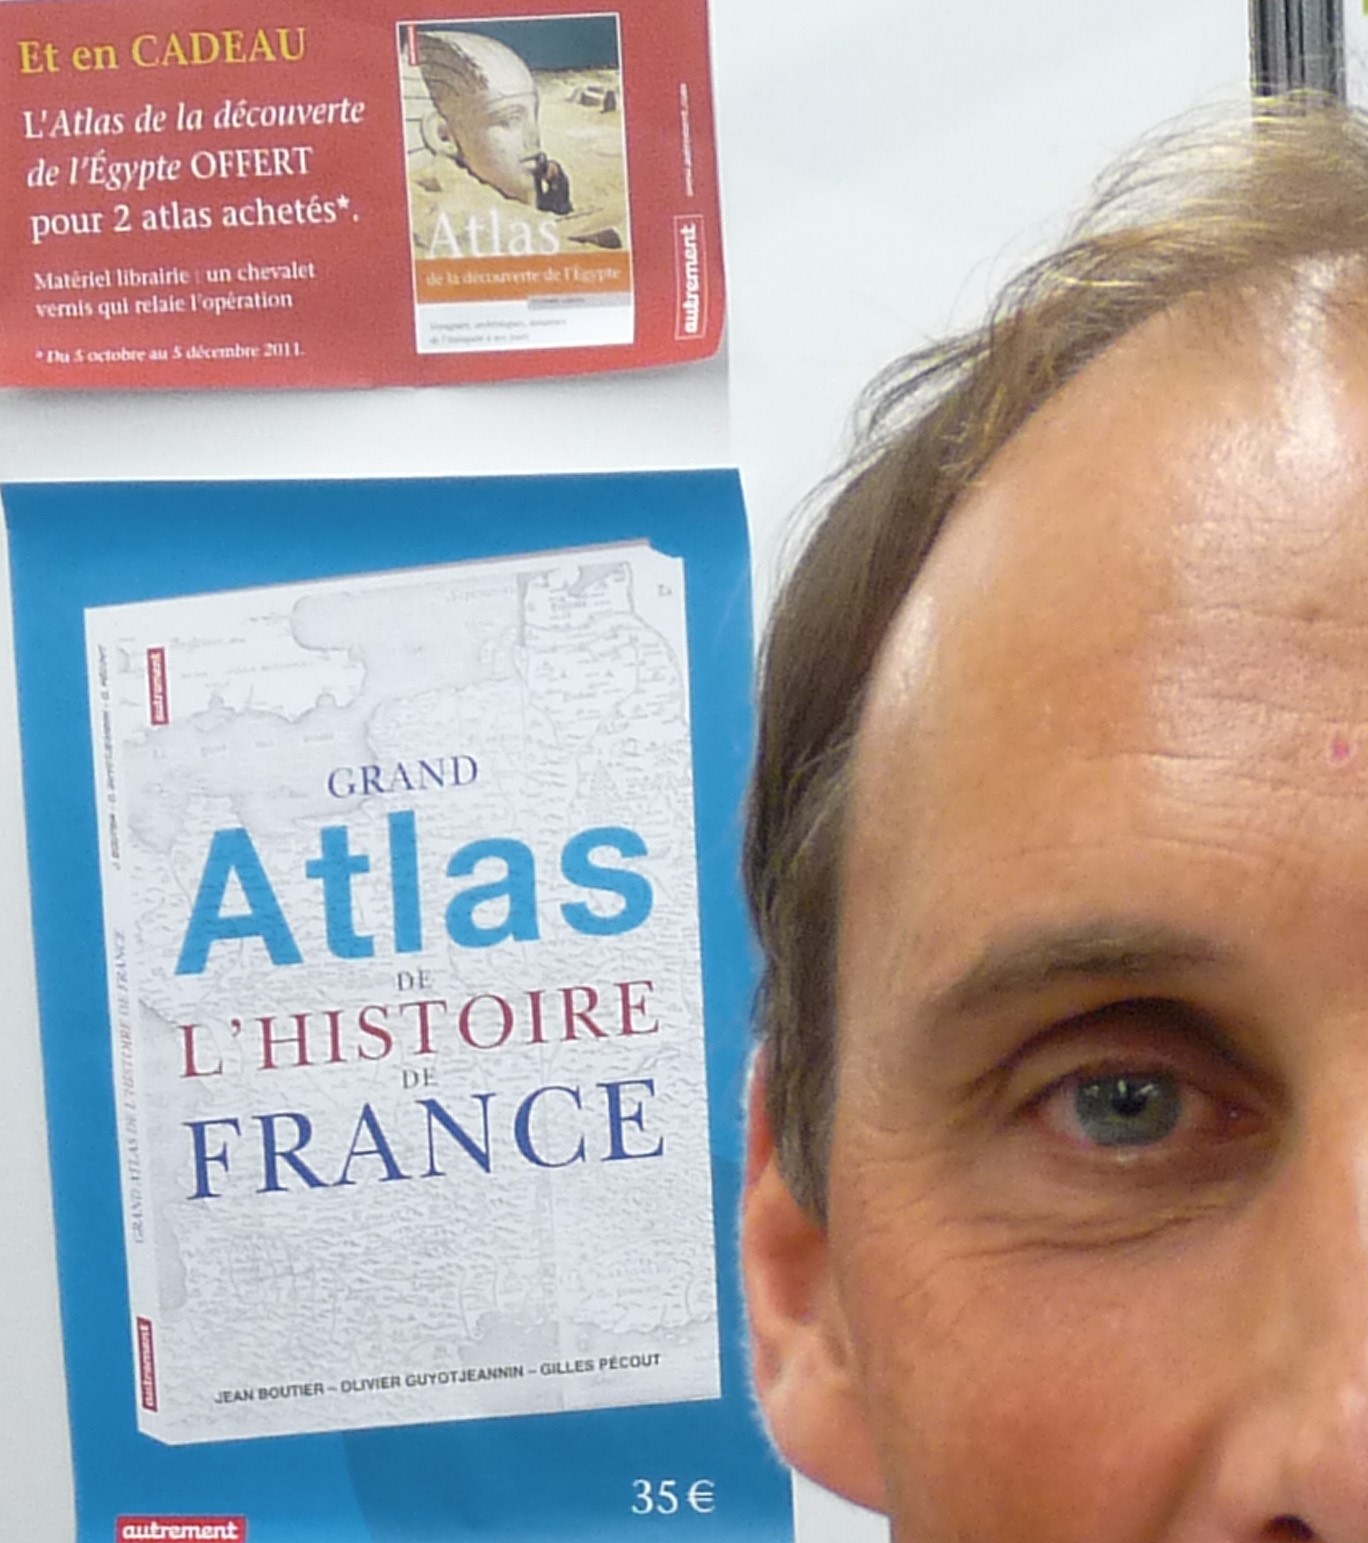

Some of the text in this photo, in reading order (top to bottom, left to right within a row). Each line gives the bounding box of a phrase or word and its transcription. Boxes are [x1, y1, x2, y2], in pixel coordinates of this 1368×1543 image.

[18, 27, 306, 74] Et en CADEAU
[23, 96, 366, 140] L'Atlas de la découverte
[27, 146, 314, 192] de l'Égypte OFFERT
[30, 211, 104, 245] pour
[113, 204, 133, 233] 2
[142, 201, 212, 231] atlas
[425, 208, 560, 260] Atlas
[34, 261, 316, 291] Matériel librairie un chevalet
[680, 223, 700, 334] autrement
[35, 291, 294, 320] vernis qui relaie l'opération
[87, 345, 147, 364] octobre
[148, 348, 169, 361] au
[186, 342, 260, 360] décembre
[327, 755, 478, 798] GRAND
[174, 810, 654, 976] Atlas
[396, 970, 433, 992] DE
[179, 979, 660, 1078] L'HISTOIRE
[402, 1067, 439, 1090] DE
[182, 1078, 665, 1201] FRANCE
[214, 1388, 255, 1405] JEAN
[258, 1381, 325, 1401] BOUTIER
[340, 1375, 402, 1394] OLIVIER
[405, 1364, 525, 1389] GUYOTJEANNIN
[540, 1358, 595, 1378] GILLES
[598, 1352, 662, 1371] PÉCOUT
[121, 1519, 240, 1542] autrement
